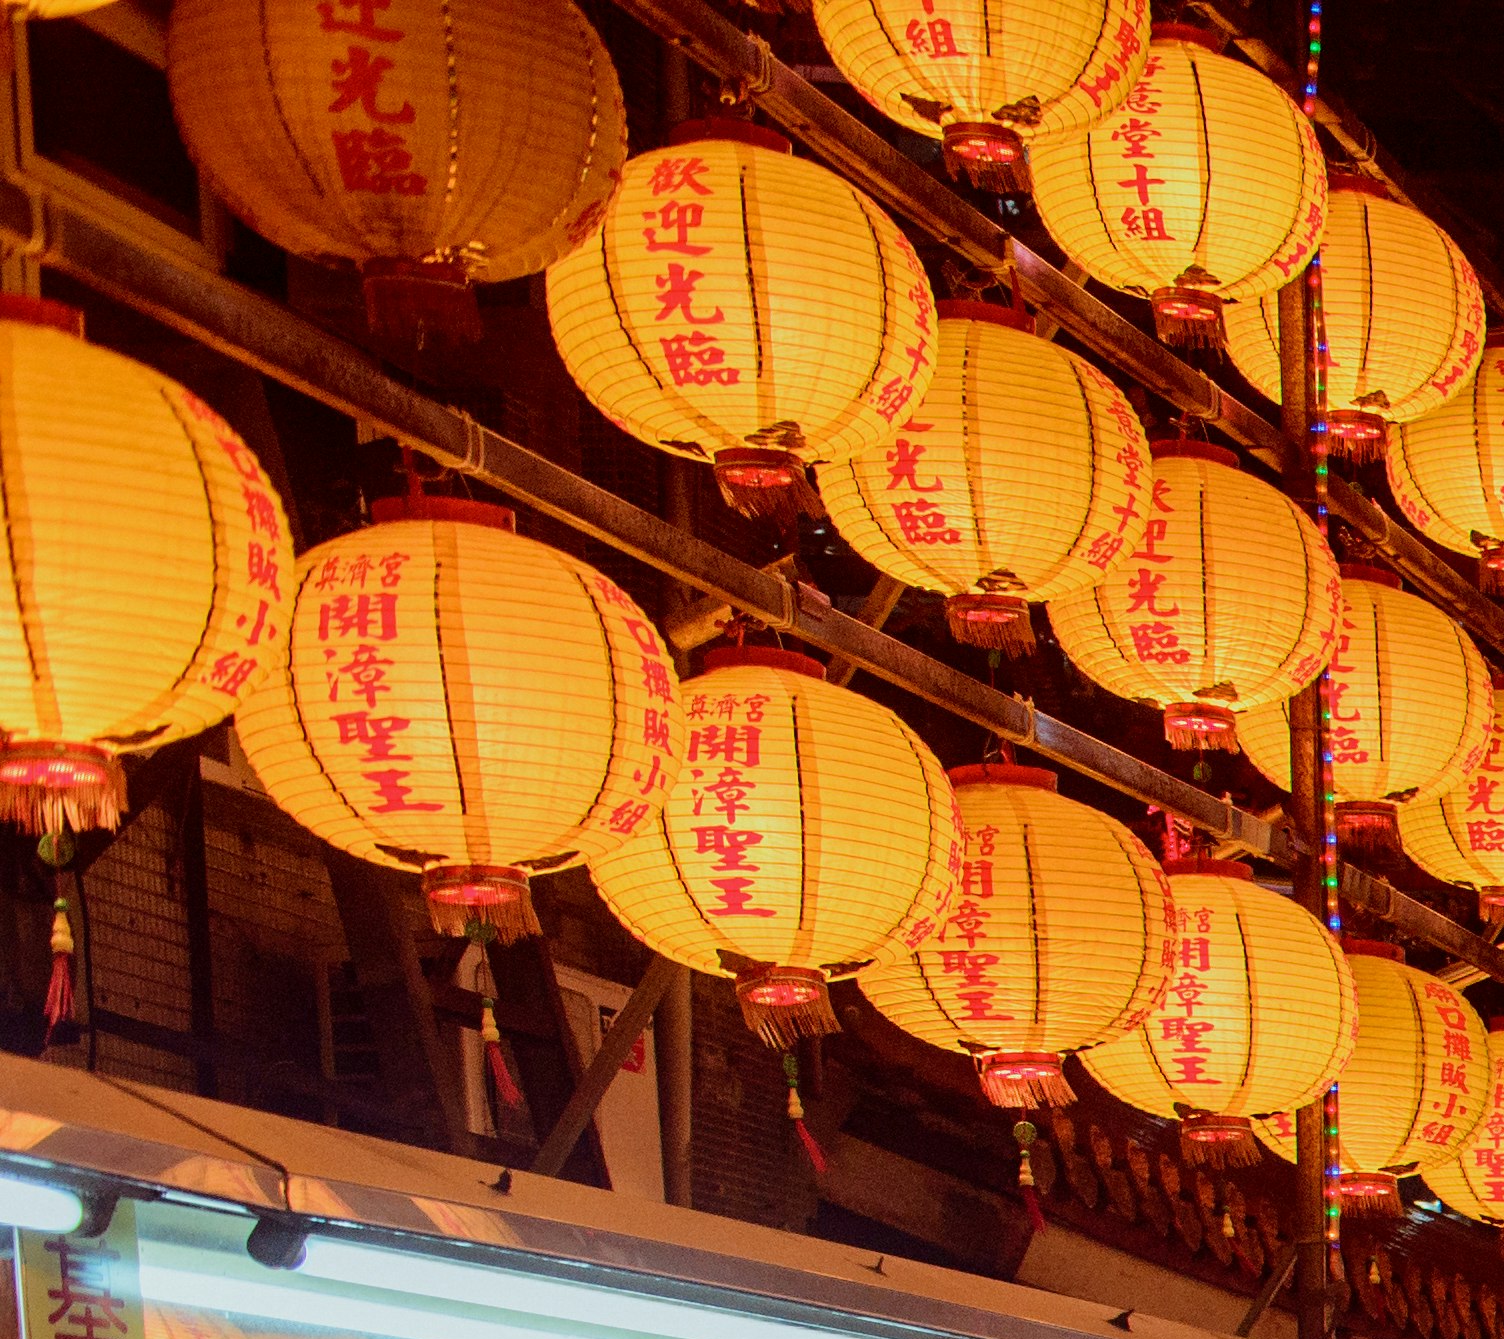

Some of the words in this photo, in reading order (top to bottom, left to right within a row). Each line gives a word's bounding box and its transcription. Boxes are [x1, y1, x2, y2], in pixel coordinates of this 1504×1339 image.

[644, 159, 739, 387] 歡迎光臨
[320, 594, 446, 814] 開漳聖王
[689, 725, 770, 918] 開漳聖王
